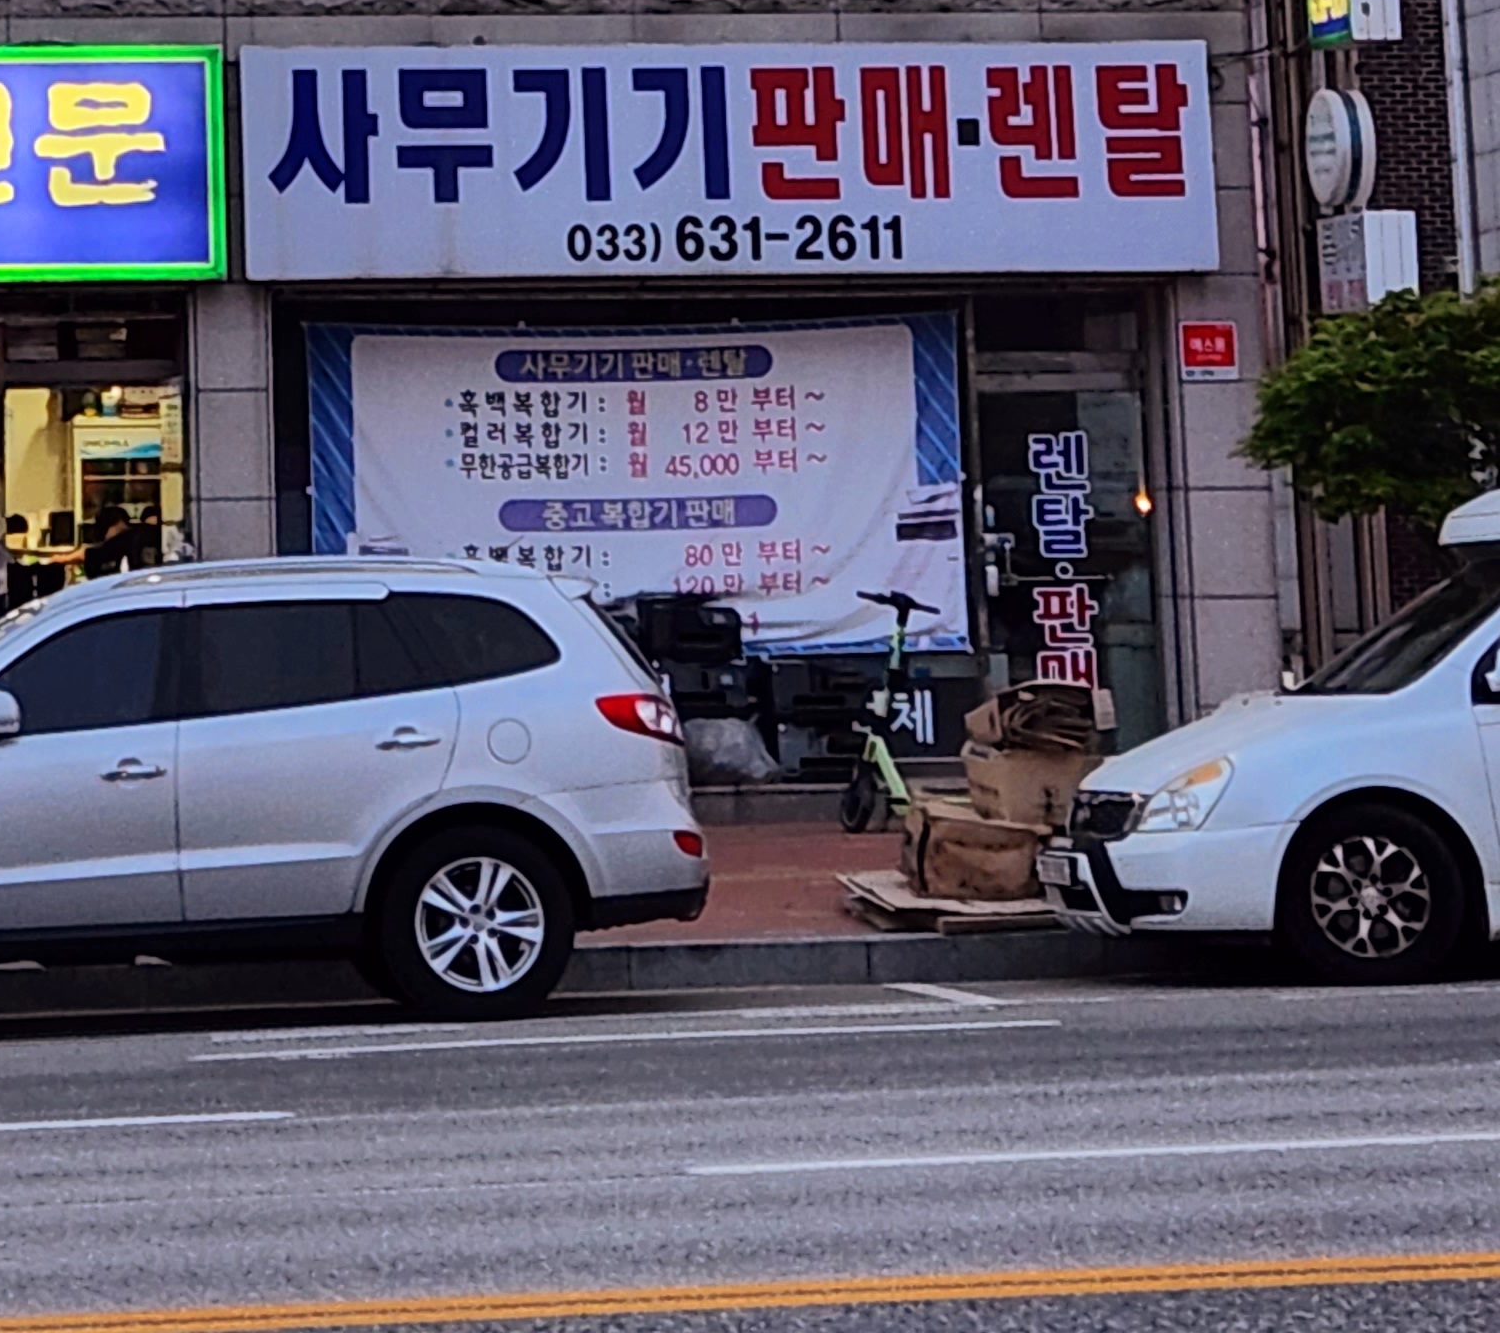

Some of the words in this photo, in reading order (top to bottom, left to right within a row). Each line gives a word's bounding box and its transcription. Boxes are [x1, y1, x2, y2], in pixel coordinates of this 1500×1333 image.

[520, 351, 623, 380] 사무기기
[541, 501, 596, 530] 중고
[601, 500, 679, 529] 복합기
[685, 498, 735, 528] 판매
